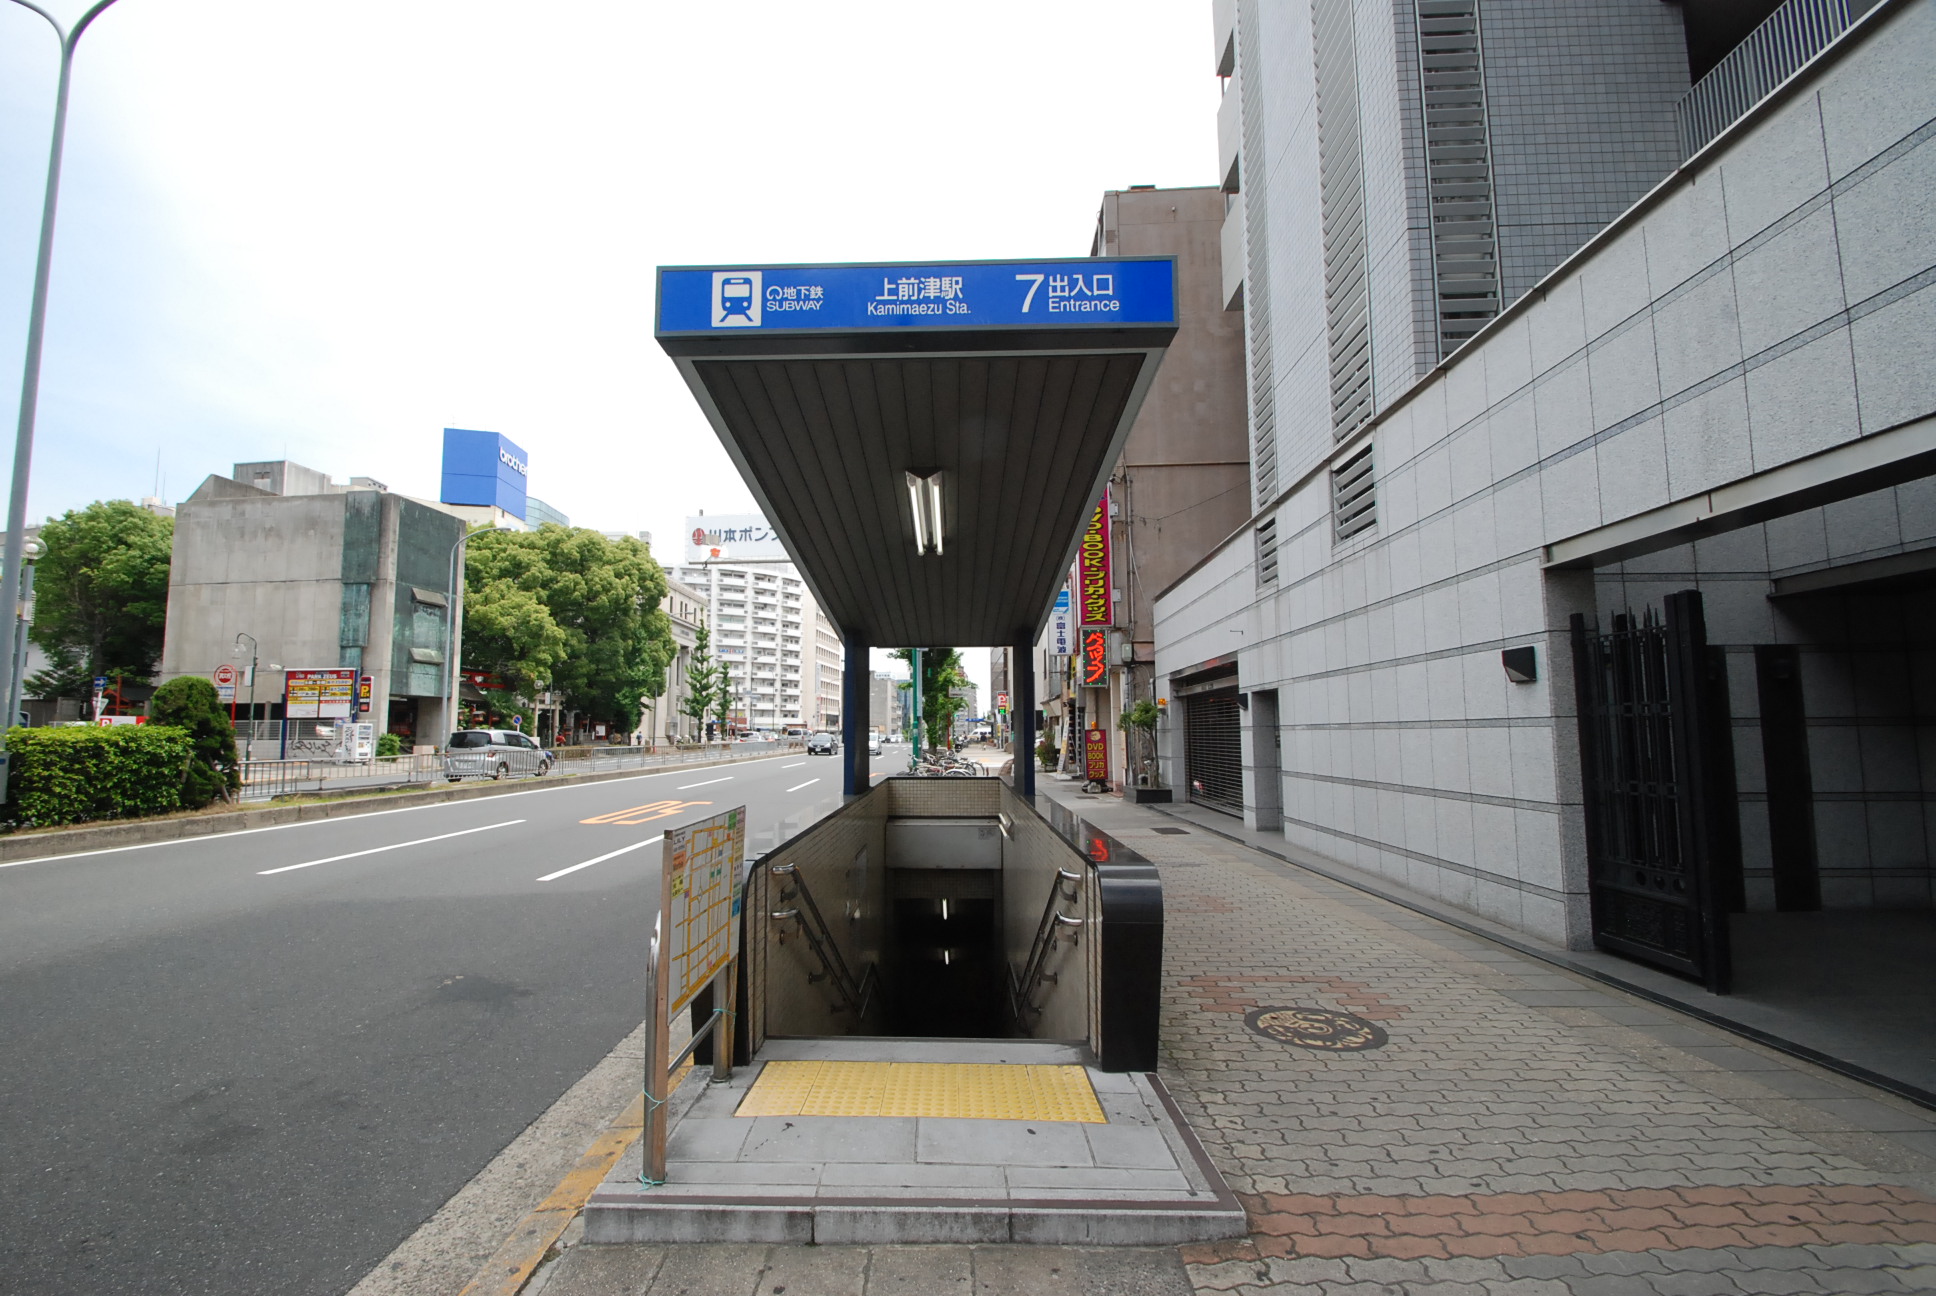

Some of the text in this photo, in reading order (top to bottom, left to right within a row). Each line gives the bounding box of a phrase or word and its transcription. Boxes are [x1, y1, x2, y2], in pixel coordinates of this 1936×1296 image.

[782, 285, 824, 300] 地下鉄
[875, 276, 963, 300] 上前津駅
[1015, 273, 1045, 313] 7
[1048, 273, 1114, 298] 出入口
[766, 300, 824, 312] SUBWAY
[867, 300, 972, 316] Kamimaezu Sta.
[1048, 298, 1120, 313] Entrance
[499, 446, 528, 477] brother
